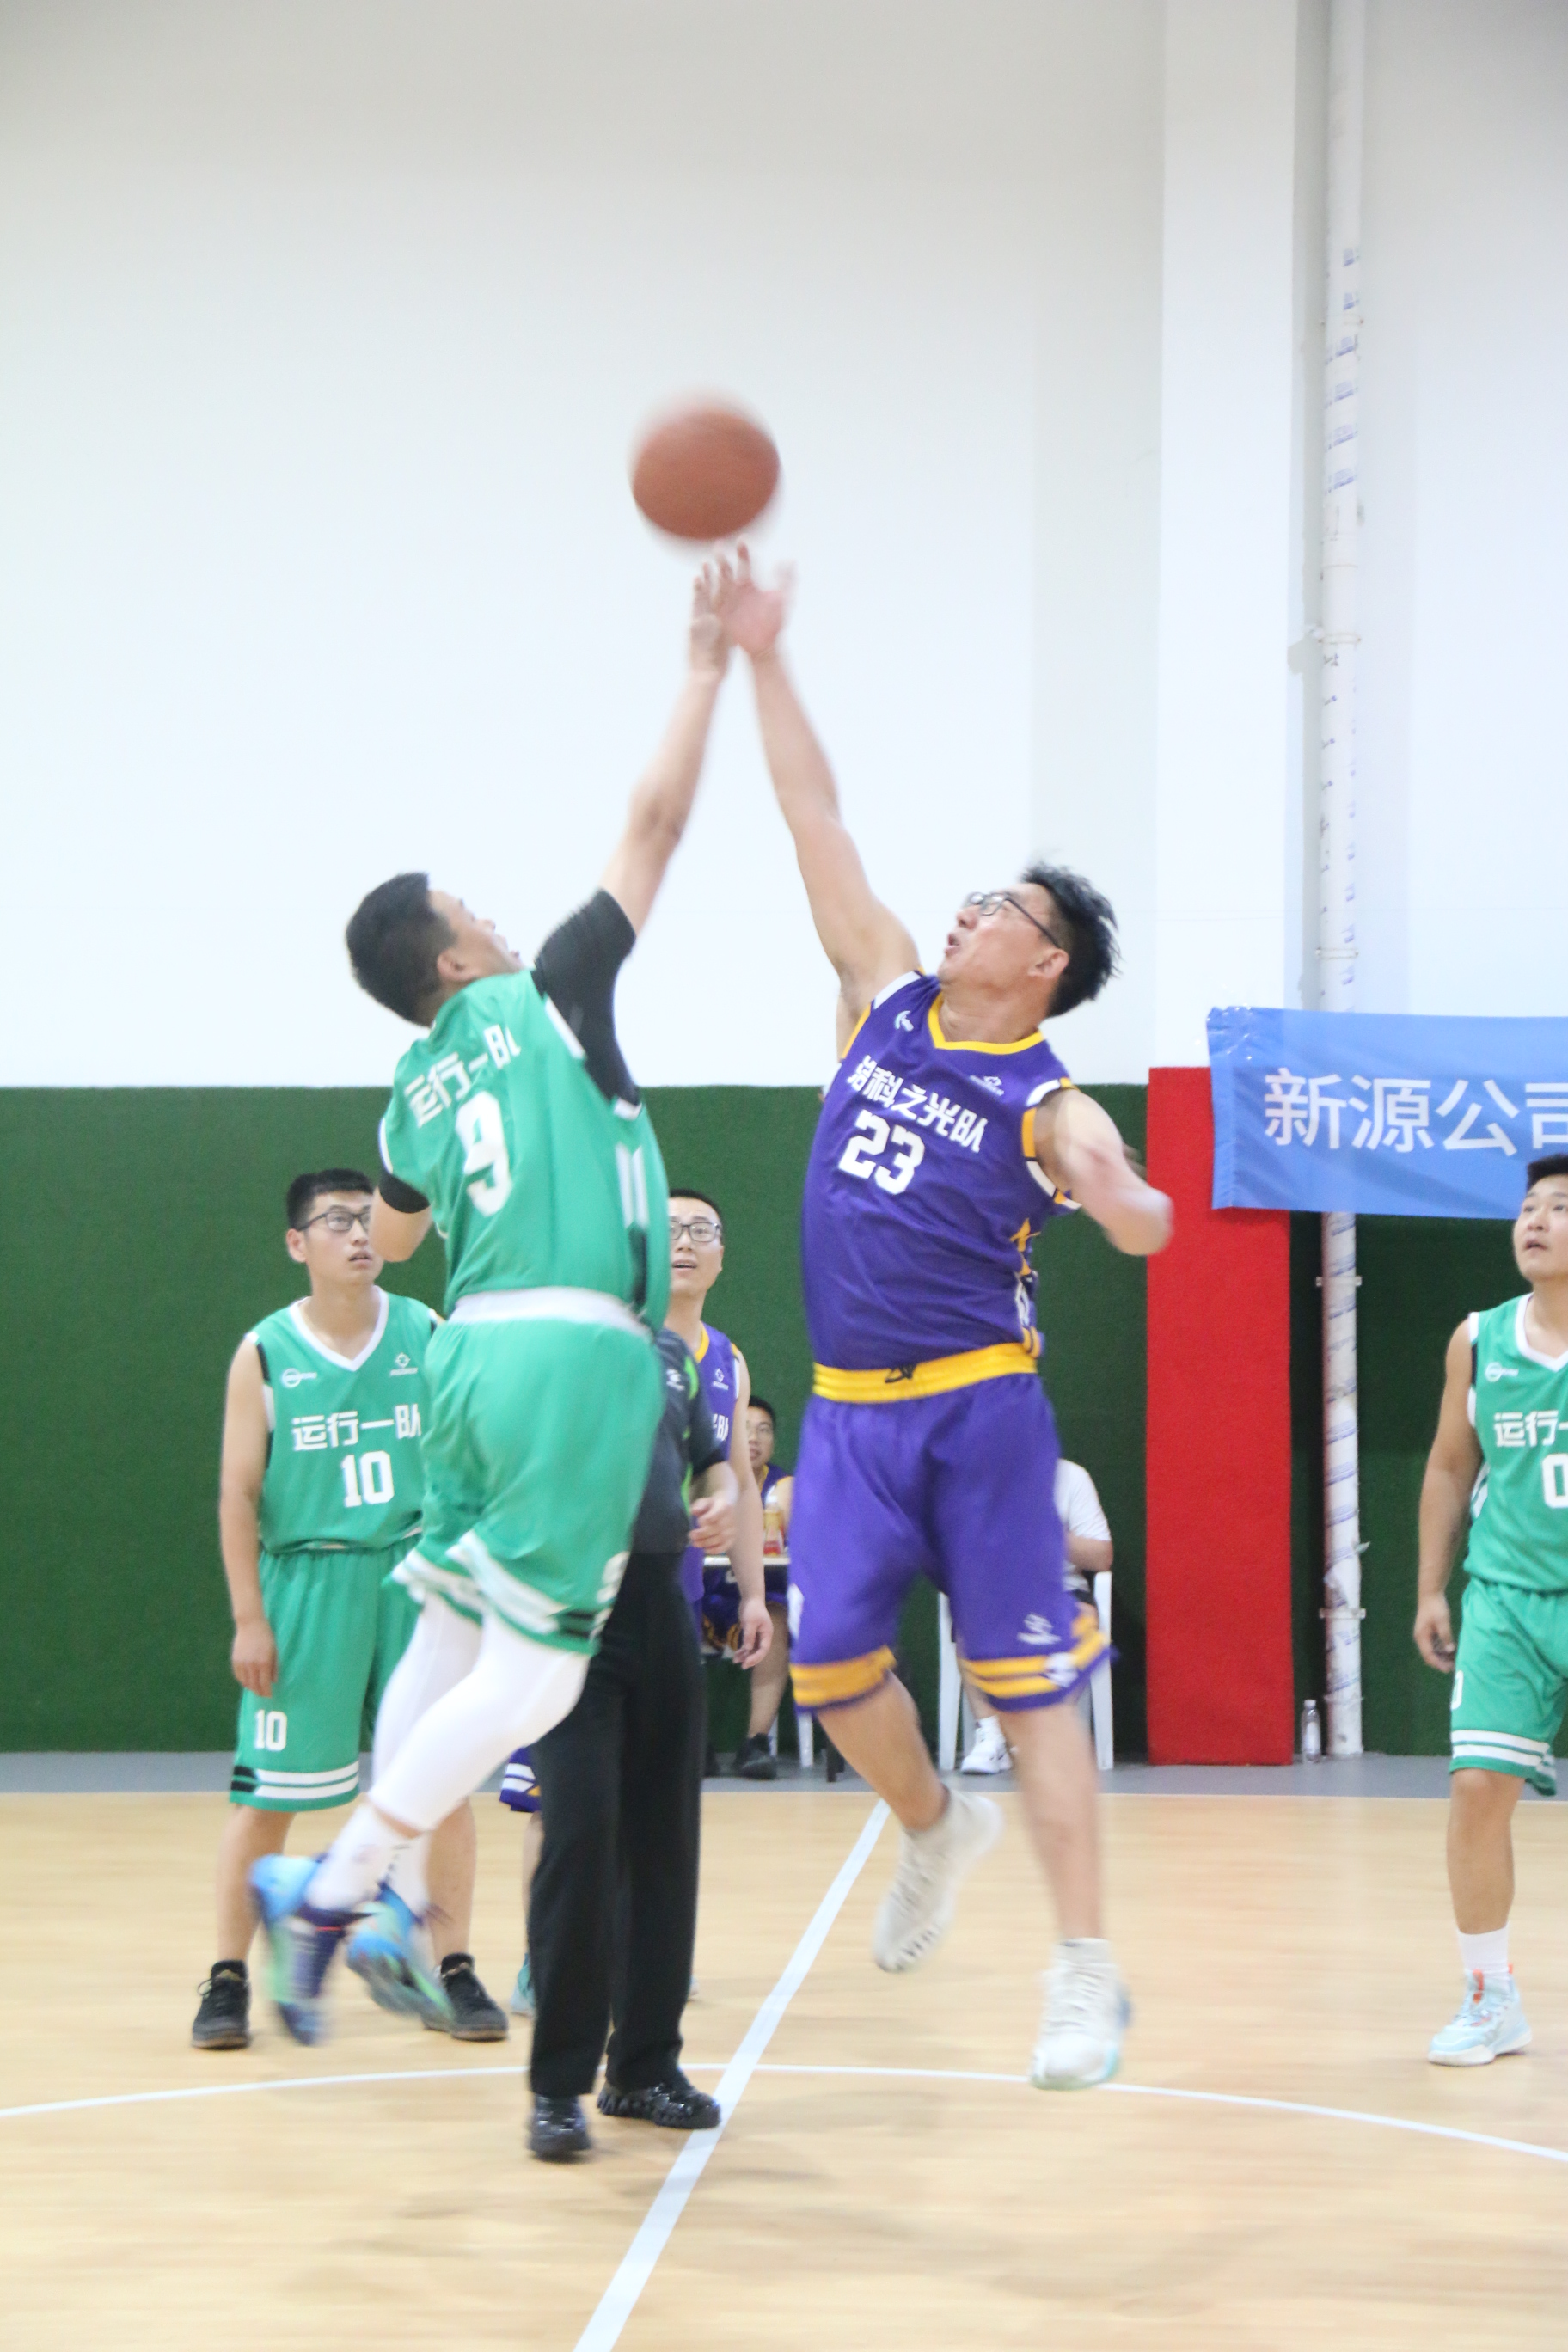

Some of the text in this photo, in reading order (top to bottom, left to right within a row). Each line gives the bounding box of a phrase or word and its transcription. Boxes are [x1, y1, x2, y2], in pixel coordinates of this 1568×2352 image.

[1265, 1067, 1568, 1156] 新源公司
[455, 1090, 513, 1217] 9
[838, 1109, 925, 1195] 23
[291, 1403, 422, 1451] 运行一队
[340, 1450, 395, 1508] 10
[254, 1709, 288, 1751] 10
